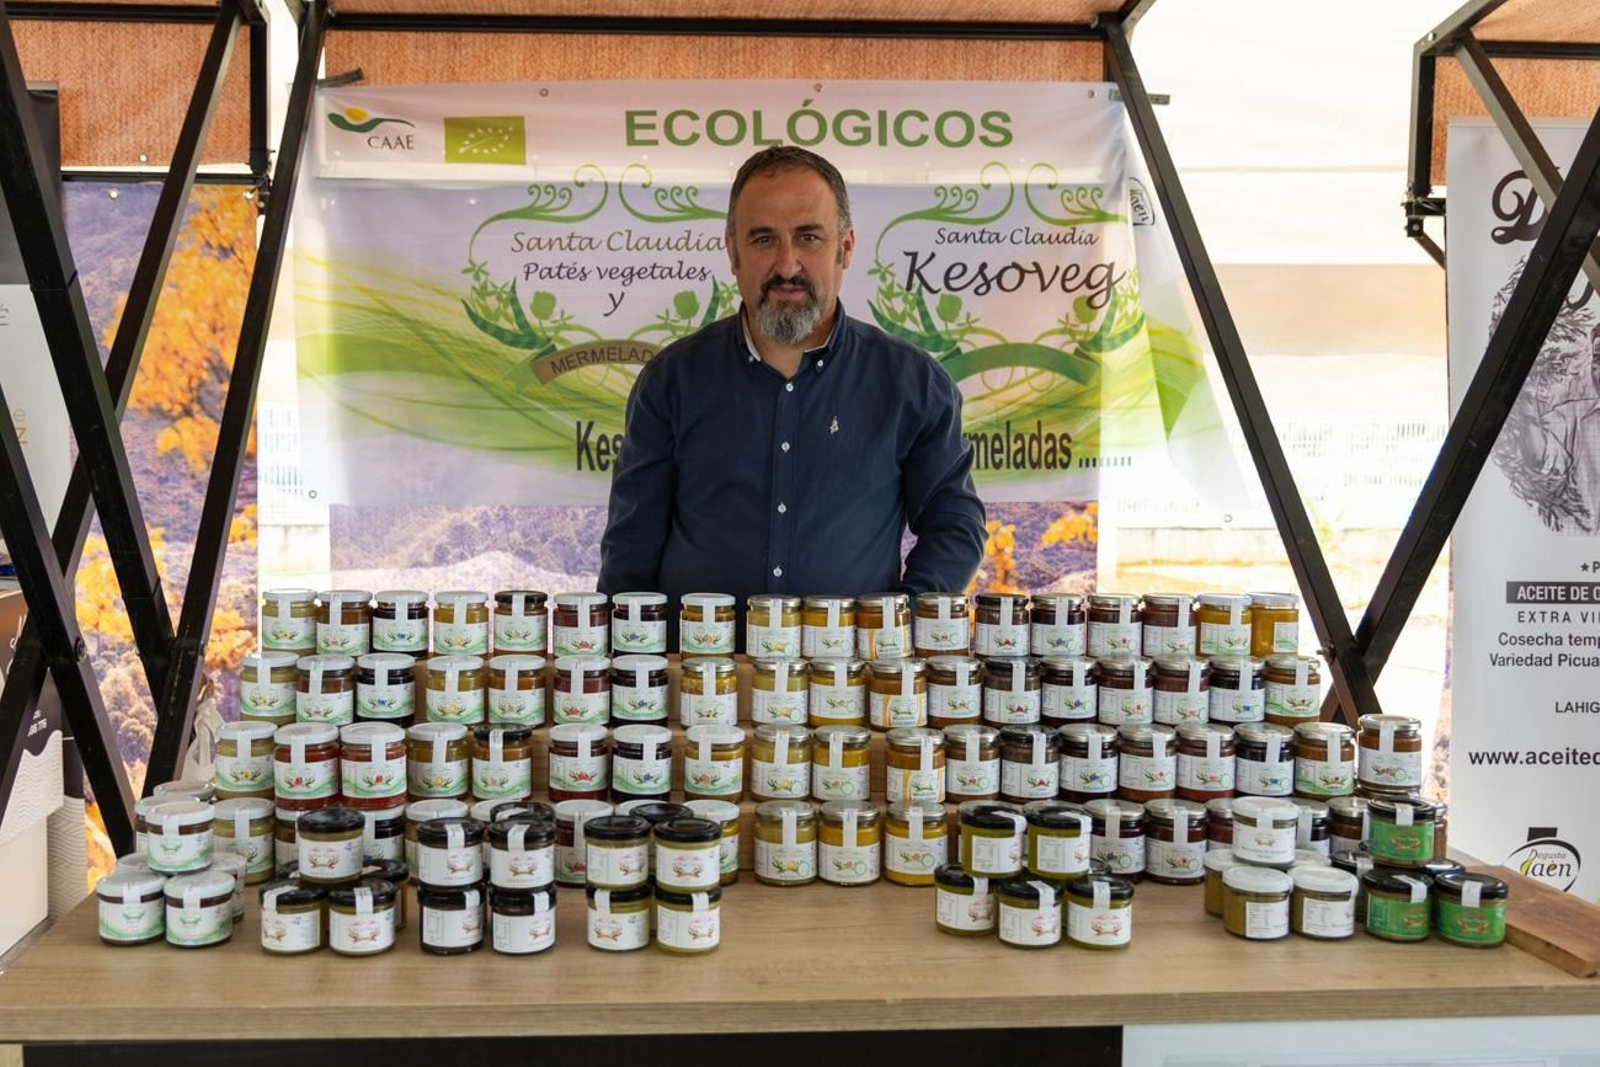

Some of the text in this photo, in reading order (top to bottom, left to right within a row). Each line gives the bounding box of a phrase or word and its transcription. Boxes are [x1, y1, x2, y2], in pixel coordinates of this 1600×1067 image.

[625, 99, 1013, 148] ECOLÓGICOS
[367, 134, 415, 150] CAAE
[511, 230, 603, 253] Santa
[935, 226, 1100, 246] Santa Claudia
[523, 260, 713, 287] Patés vegetales
[903, 251, 1127, 310] Kesoveg
[603, 291, 626, 318] y
[963, 420, 1073, 471] meladas
[1516, 586, 1567, 601] ACEITE
[1570, 586, 1590, 601] DE
[1517, 611, 1600, 625] EXTRA VI
[1498, 632, 1563, 647] Cosecha
[1489, 653, 1553, 667] Variedad
